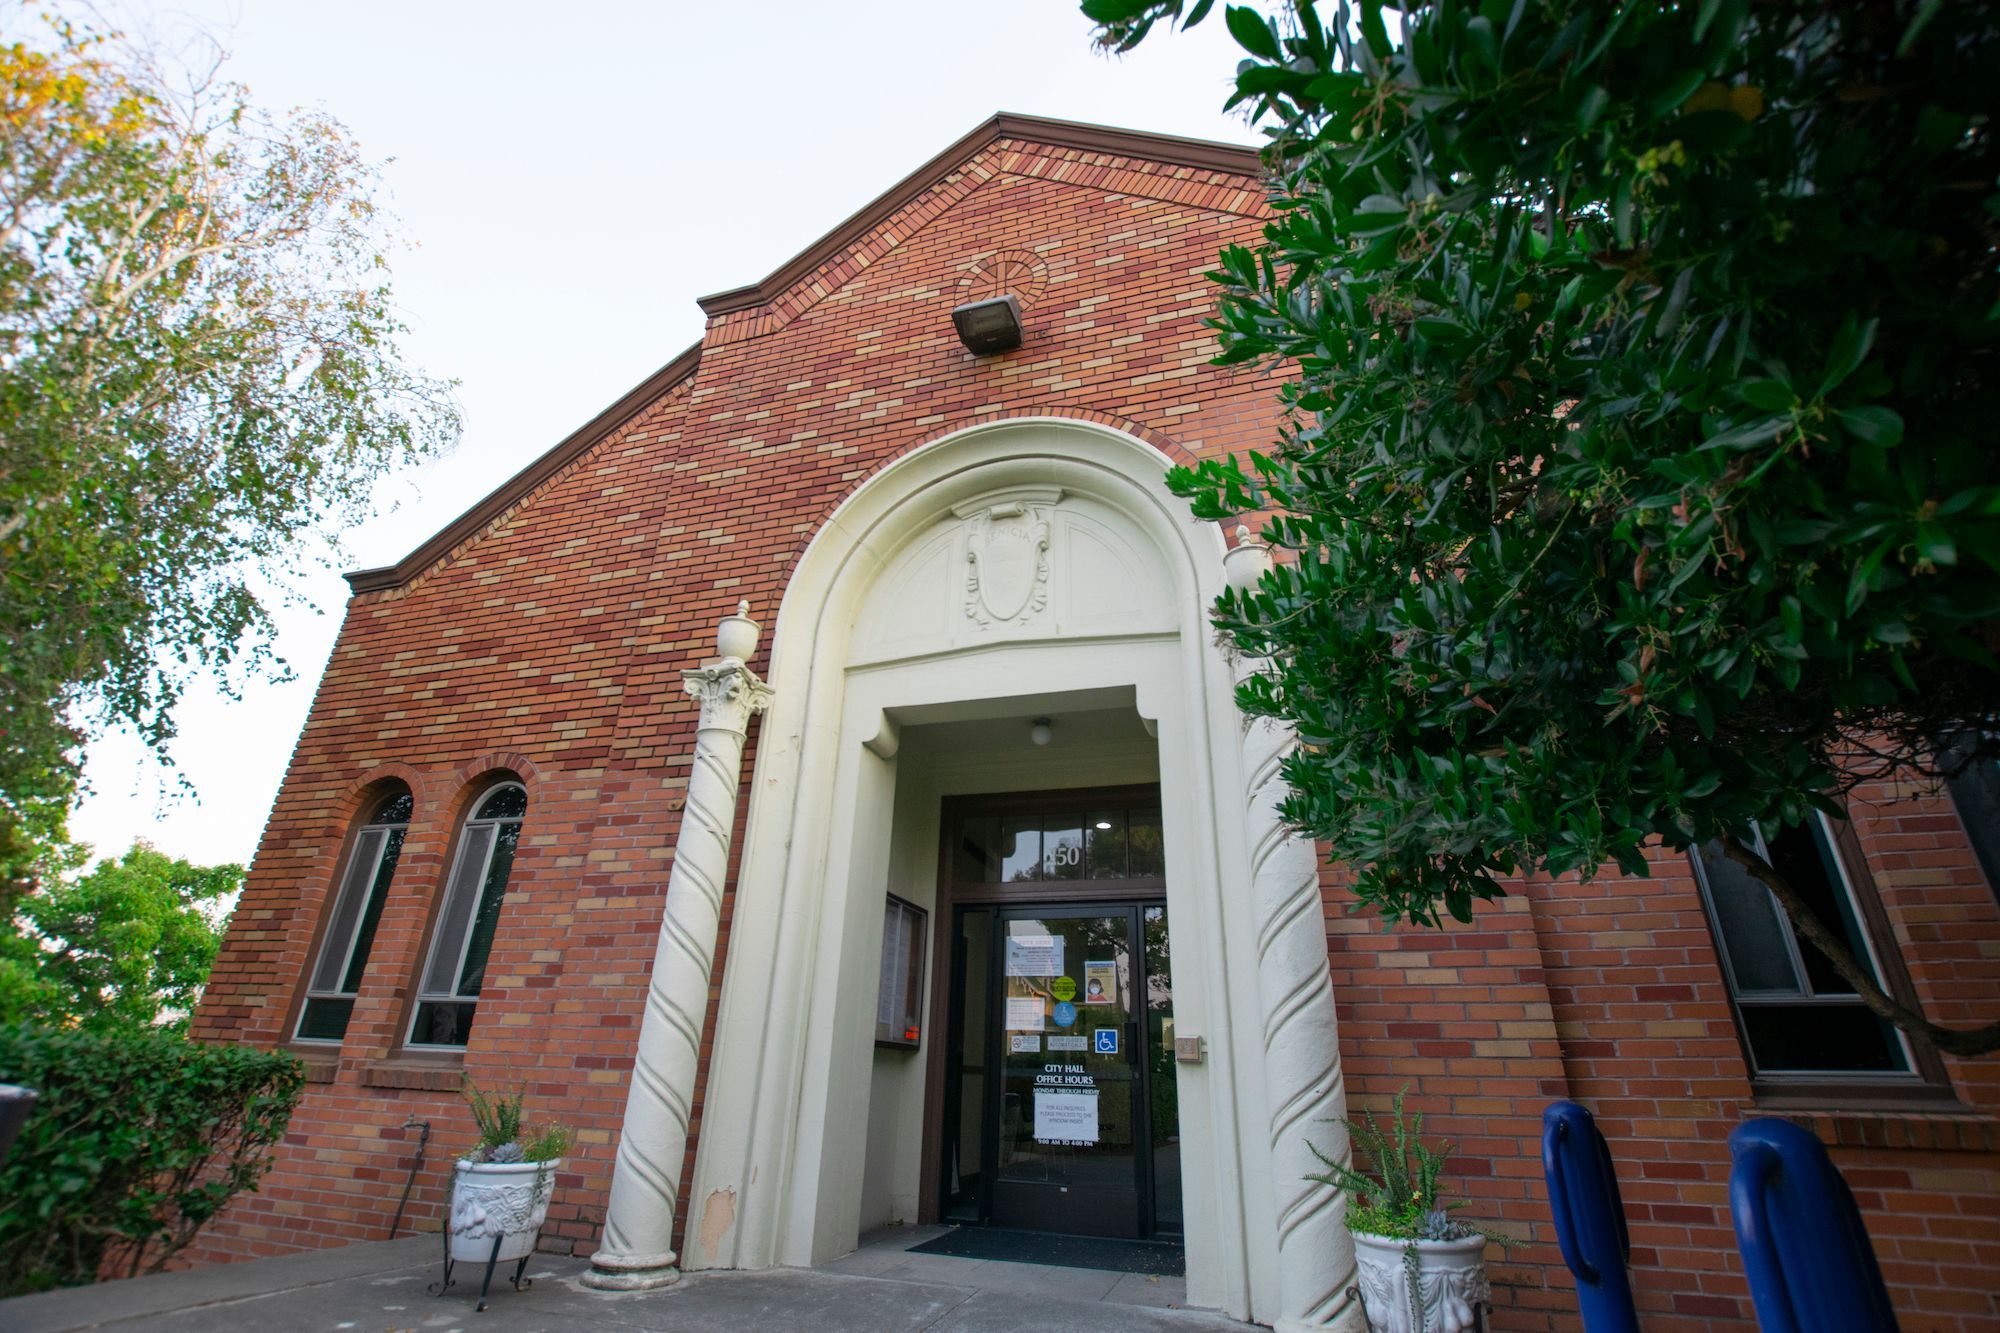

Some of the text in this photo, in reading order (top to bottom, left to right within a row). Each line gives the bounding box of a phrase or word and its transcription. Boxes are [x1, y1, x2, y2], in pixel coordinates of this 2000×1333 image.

[984, 525, 1031, 546] BENICIA
[1044, 1064, 1085, 1073] CITY HALL
[1036, 1075, 1094, 1085] OFFICE HOURS
